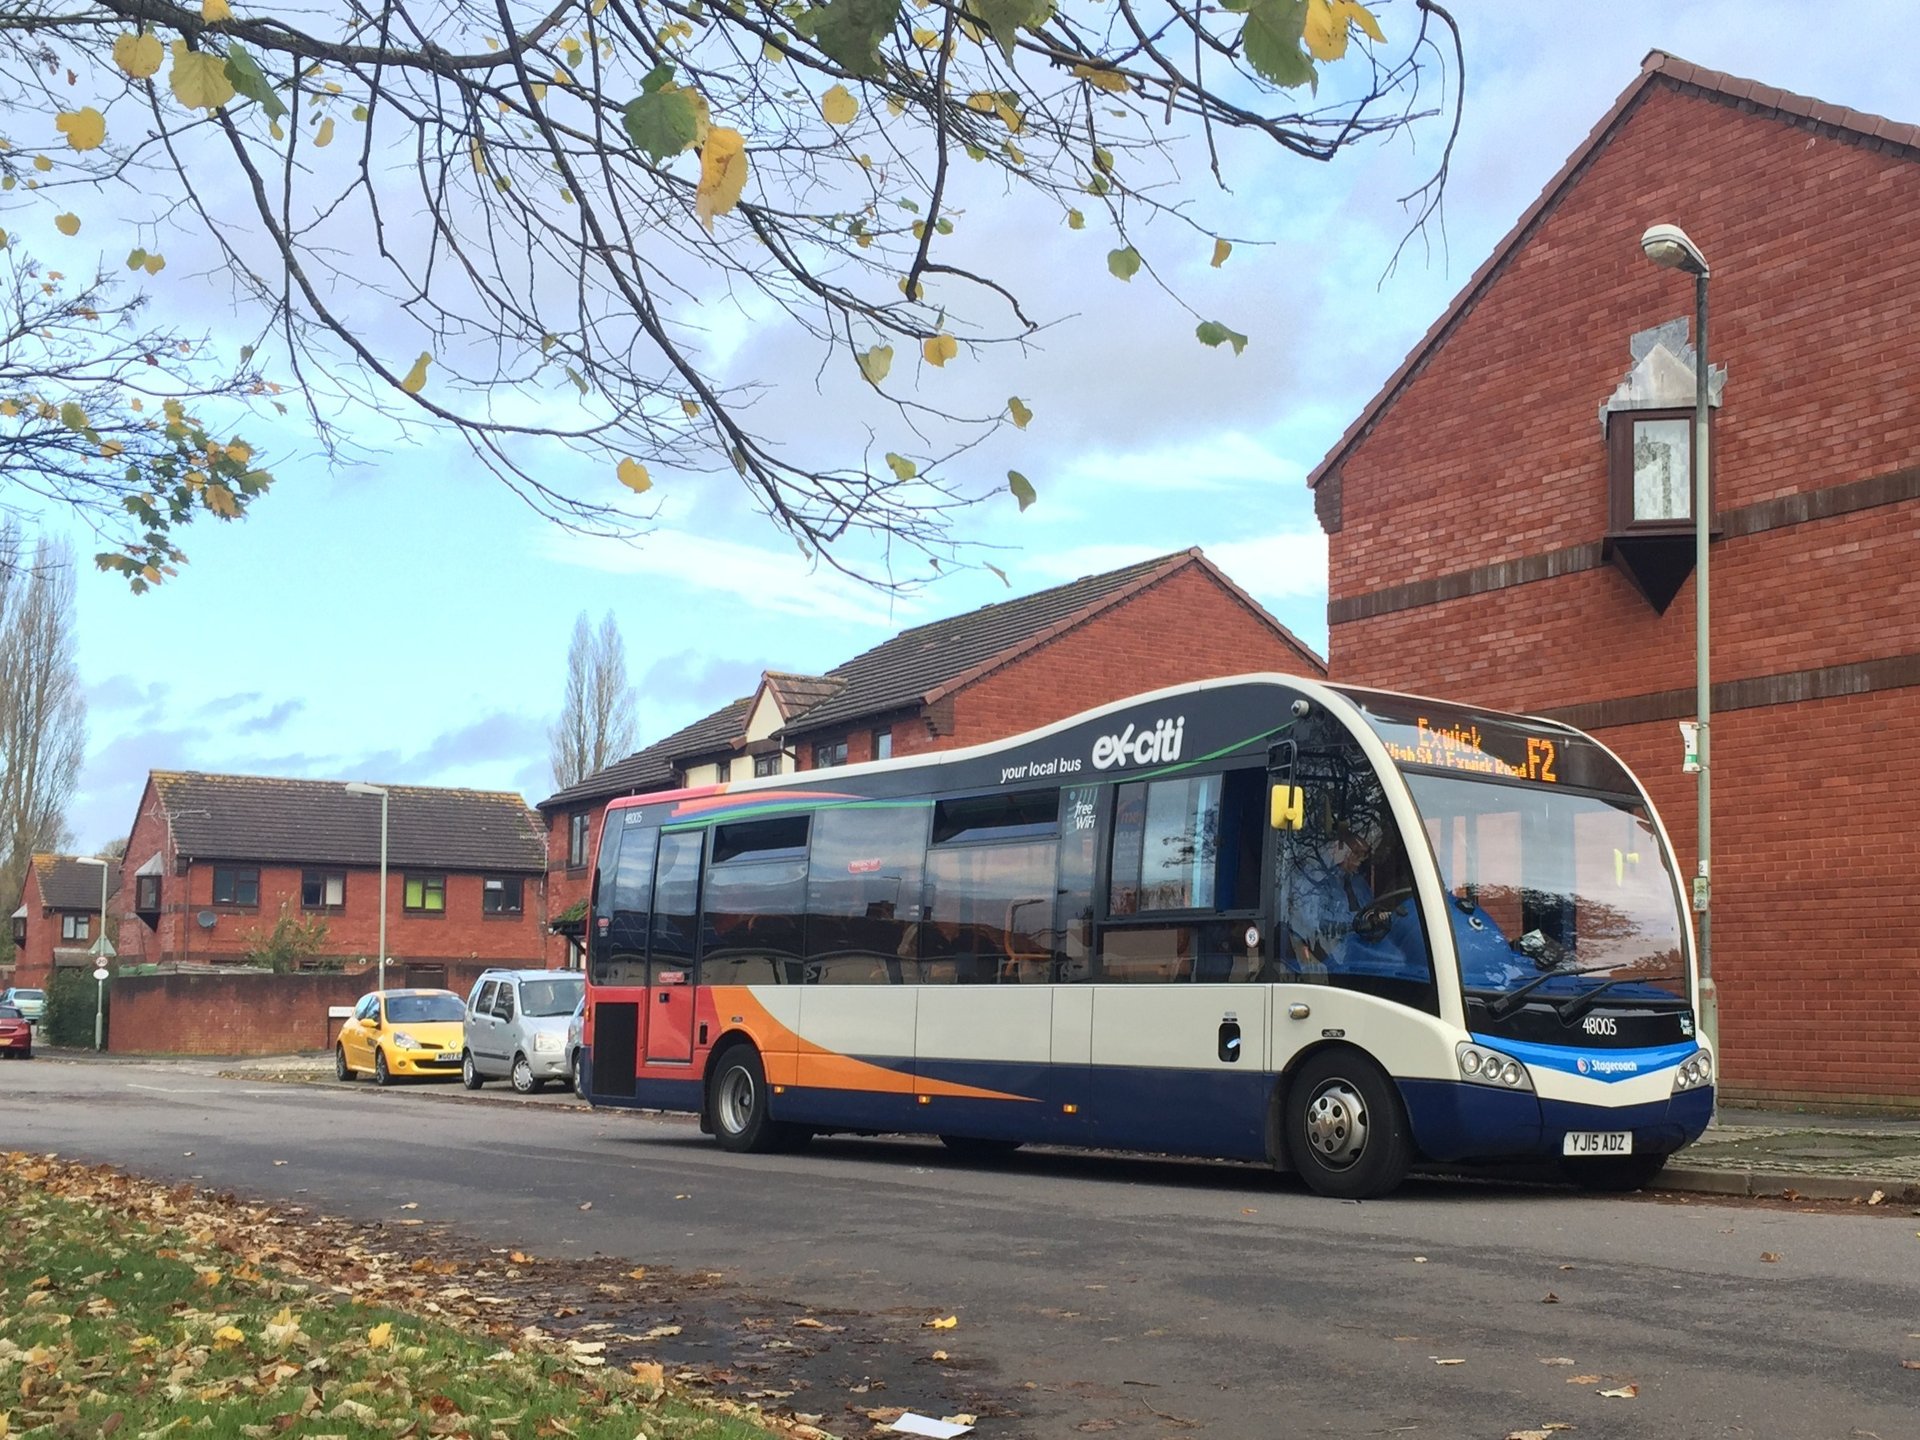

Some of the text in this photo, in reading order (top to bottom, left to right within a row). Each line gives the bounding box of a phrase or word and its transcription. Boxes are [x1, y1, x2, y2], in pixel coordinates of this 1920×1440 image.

[1092, 715, 1185, 770] ex-citi
[1418, 718, 1482, 755] Exwick
[1000, 757, 1082, 784] your local bus
[1416, 746, 1433, 764] St
[1446, 751, 1492, 773] Exwick
[1495, 758, 1527, 778] Road
[1527, 737, 1556, 782] F2
[1074, 801, 1093, 819] free
[1076, 815, 1096, 830] WiFi
[1582, 1017, 1617, 1035] 48005
[1591, 1059, 1638, 1074] Stagecoach
[1572, 1134, 1625, 1151] YJ15 ADZ
